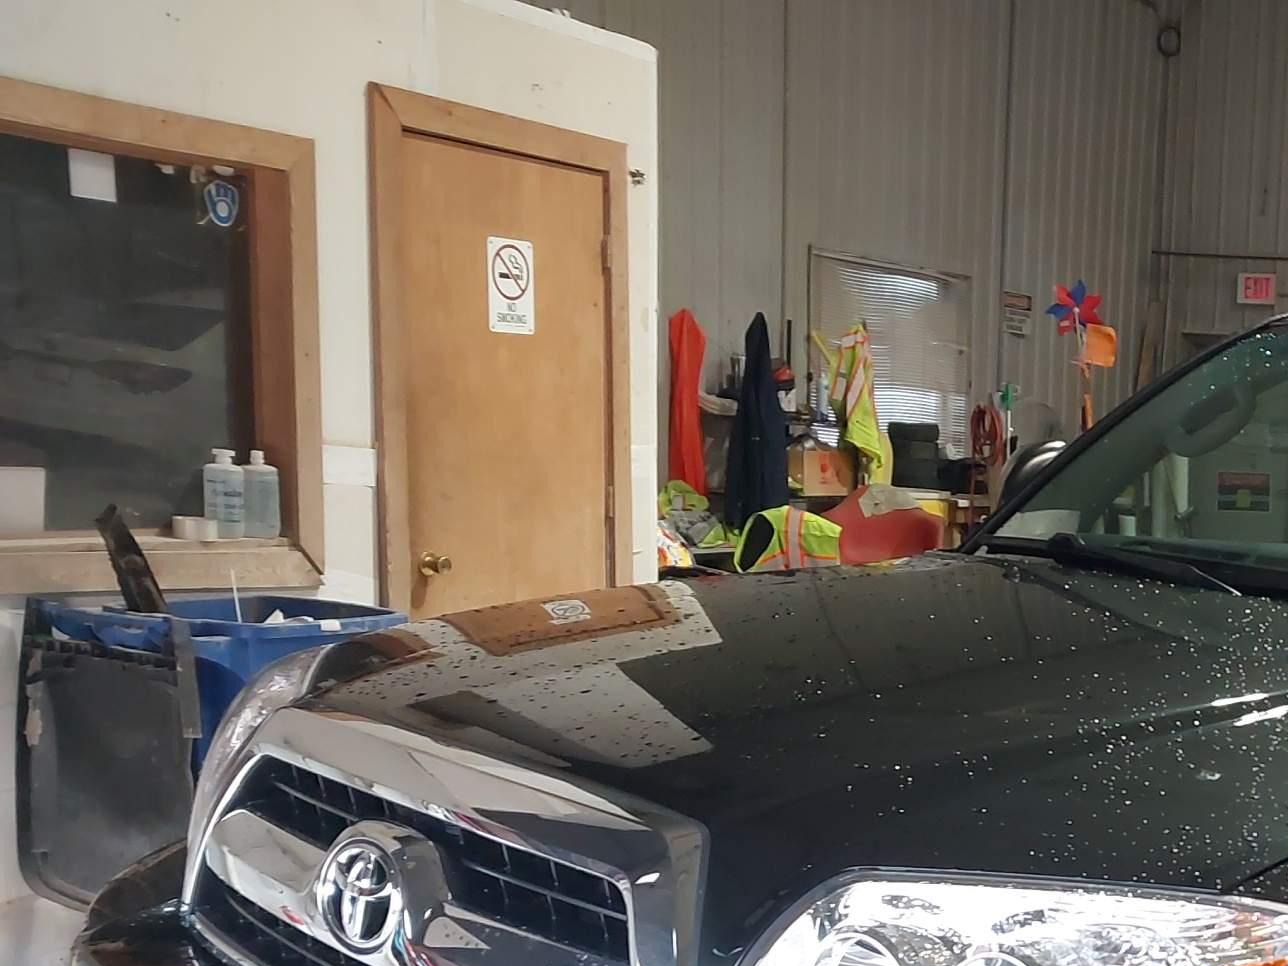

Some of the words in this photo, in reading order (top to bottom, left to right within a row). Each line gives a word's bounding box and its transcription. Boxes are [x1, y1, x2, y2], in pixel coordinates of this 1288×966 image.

[1243, 276, 1272, 299] EXIT
[506, 302, 517, 313] NO
[497, 311, 528, 325] SMOKING
